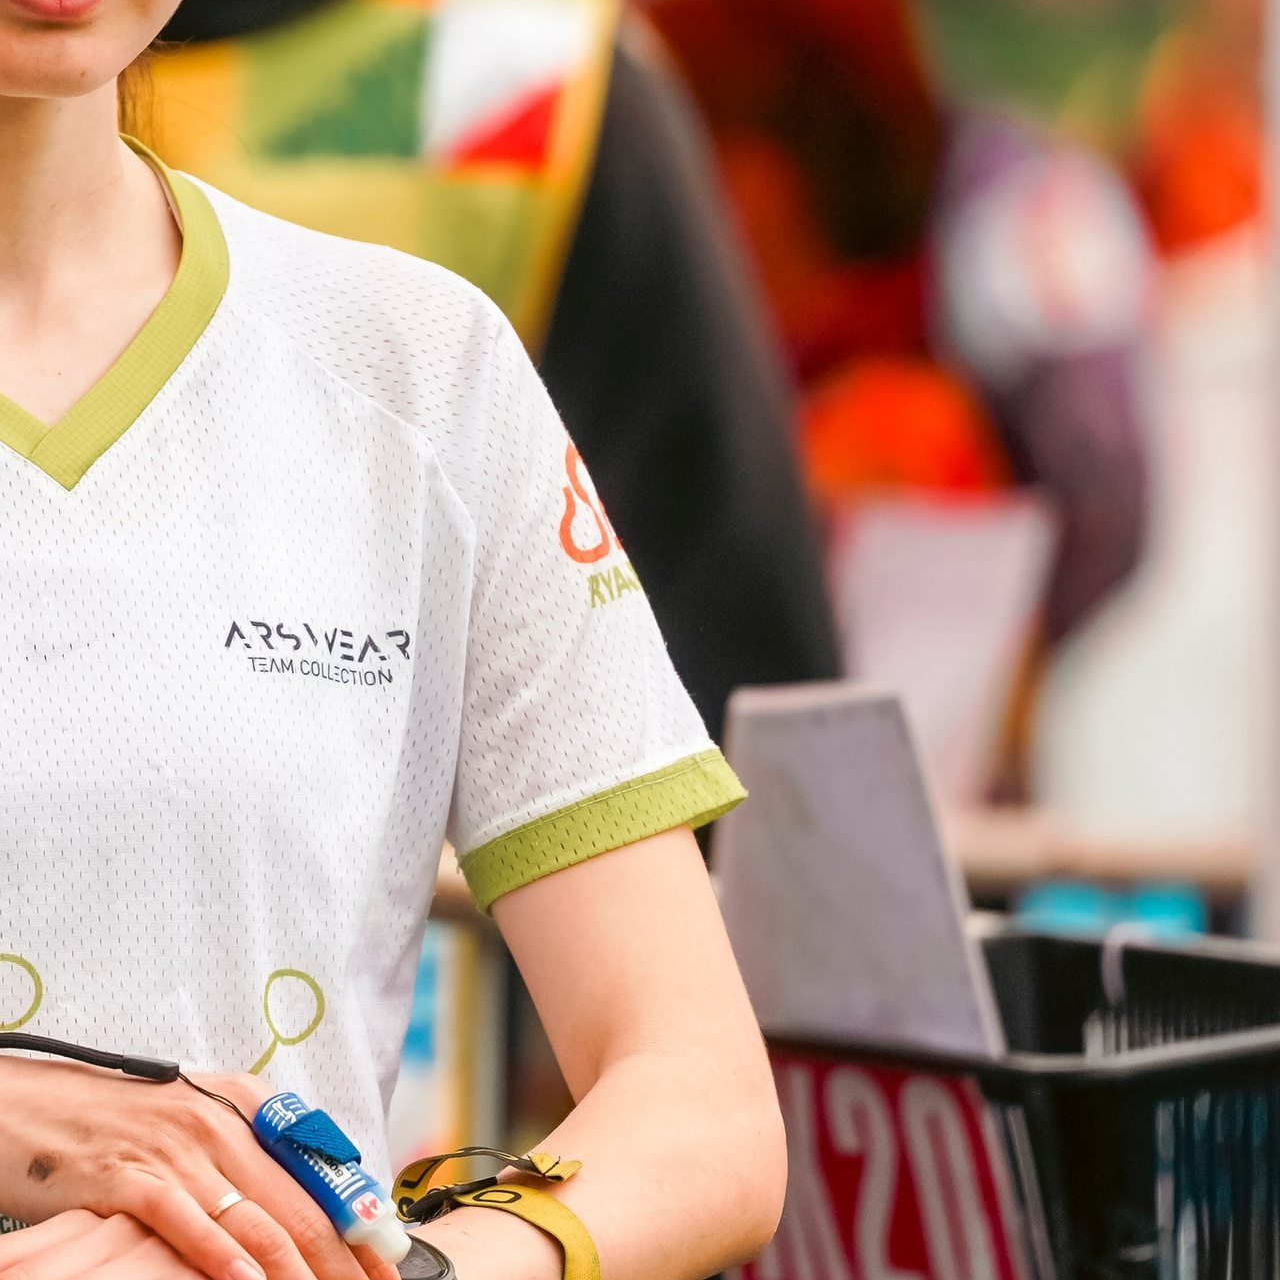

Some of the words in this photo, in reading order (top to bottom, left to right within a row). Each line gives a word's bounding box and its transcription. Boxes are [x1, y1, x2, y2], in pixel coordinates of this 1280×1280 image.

[586, 561, 641, 608] RYA
[247, 656, 295, 674] TEAM
[300, 659, 394, 686] COLLECTION
